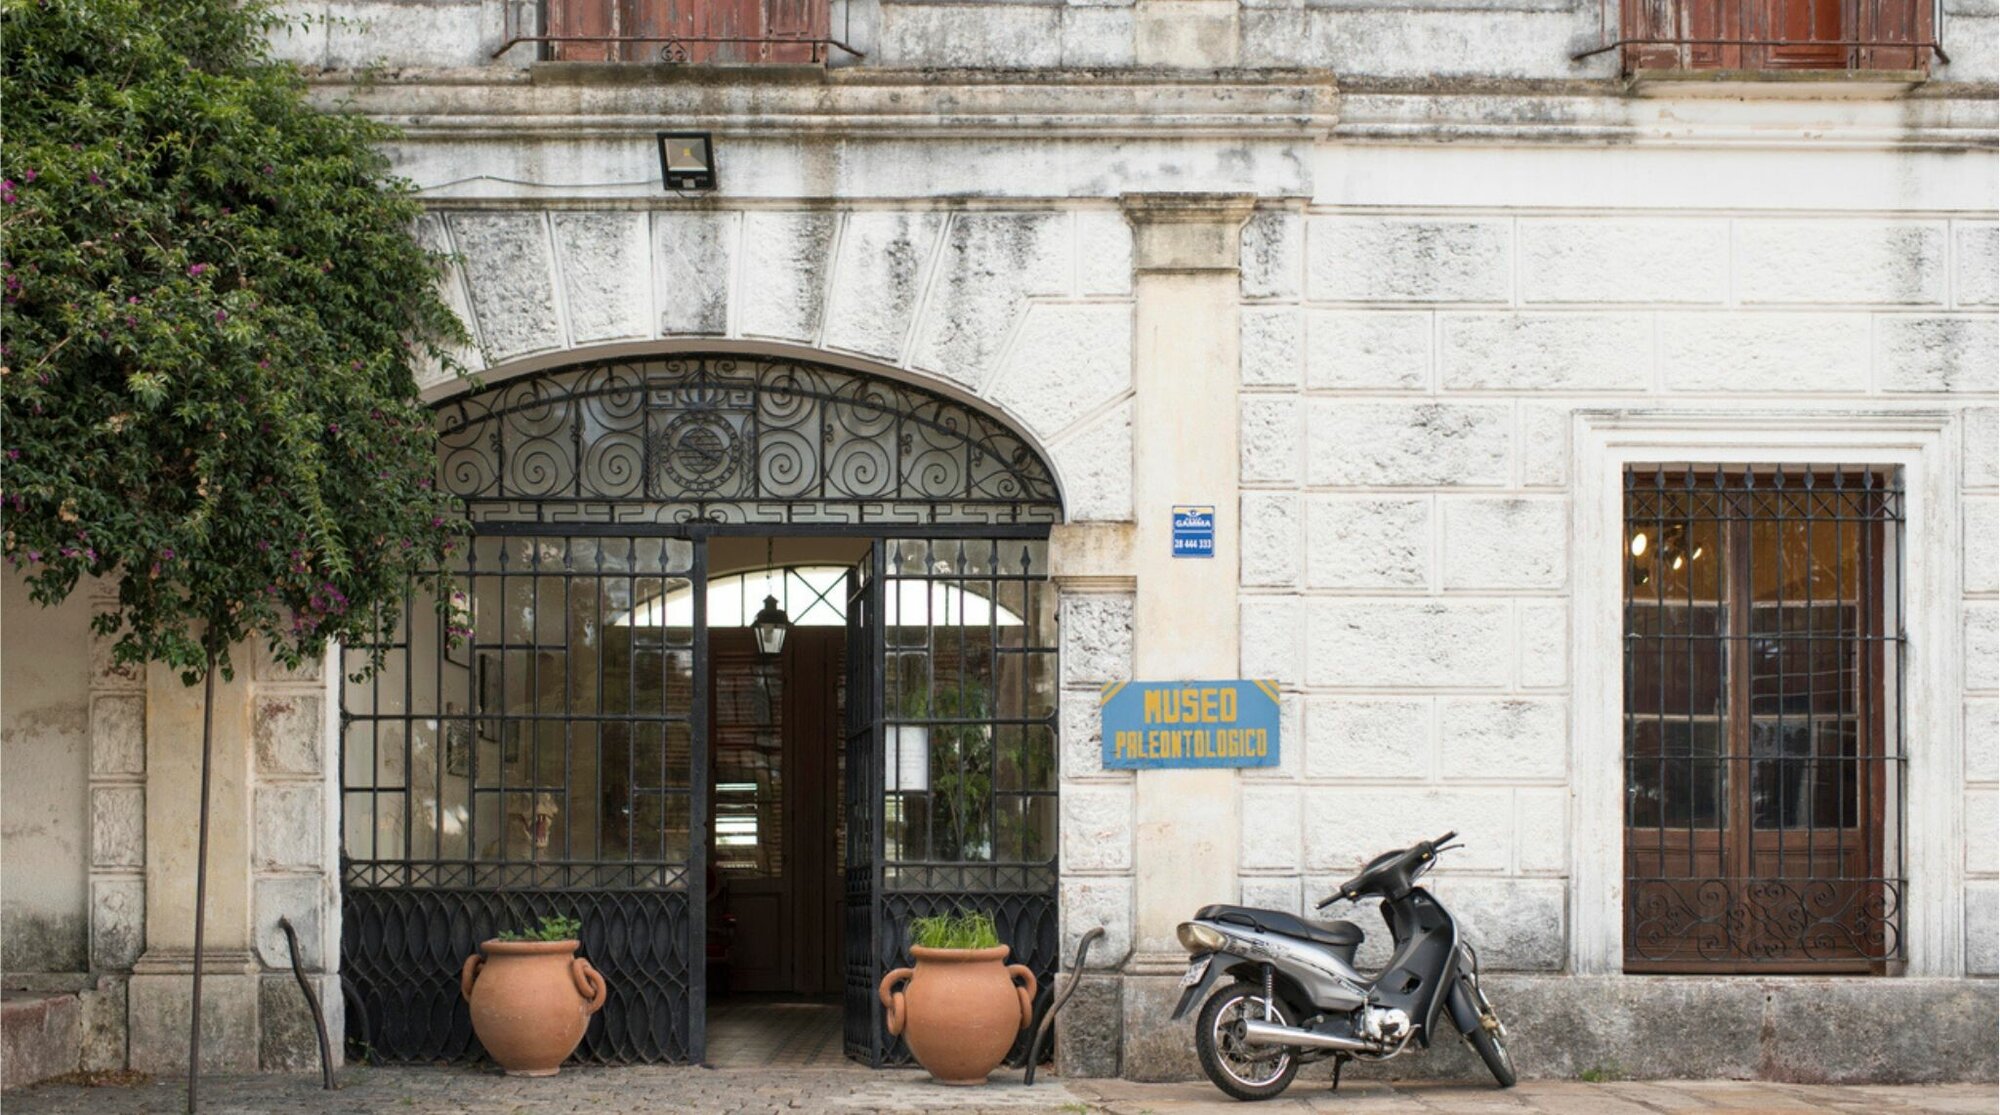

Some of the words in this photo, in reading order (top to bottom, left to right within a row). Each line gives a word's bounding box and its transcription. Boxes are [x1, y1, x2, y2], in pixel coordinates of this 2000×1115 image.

[1175, 519, 1211, 527] GAMMA
[1144, 688, 1237, 724] MUSEO
[1115, 728, 1267, 759] PALEONTOLOGICO
